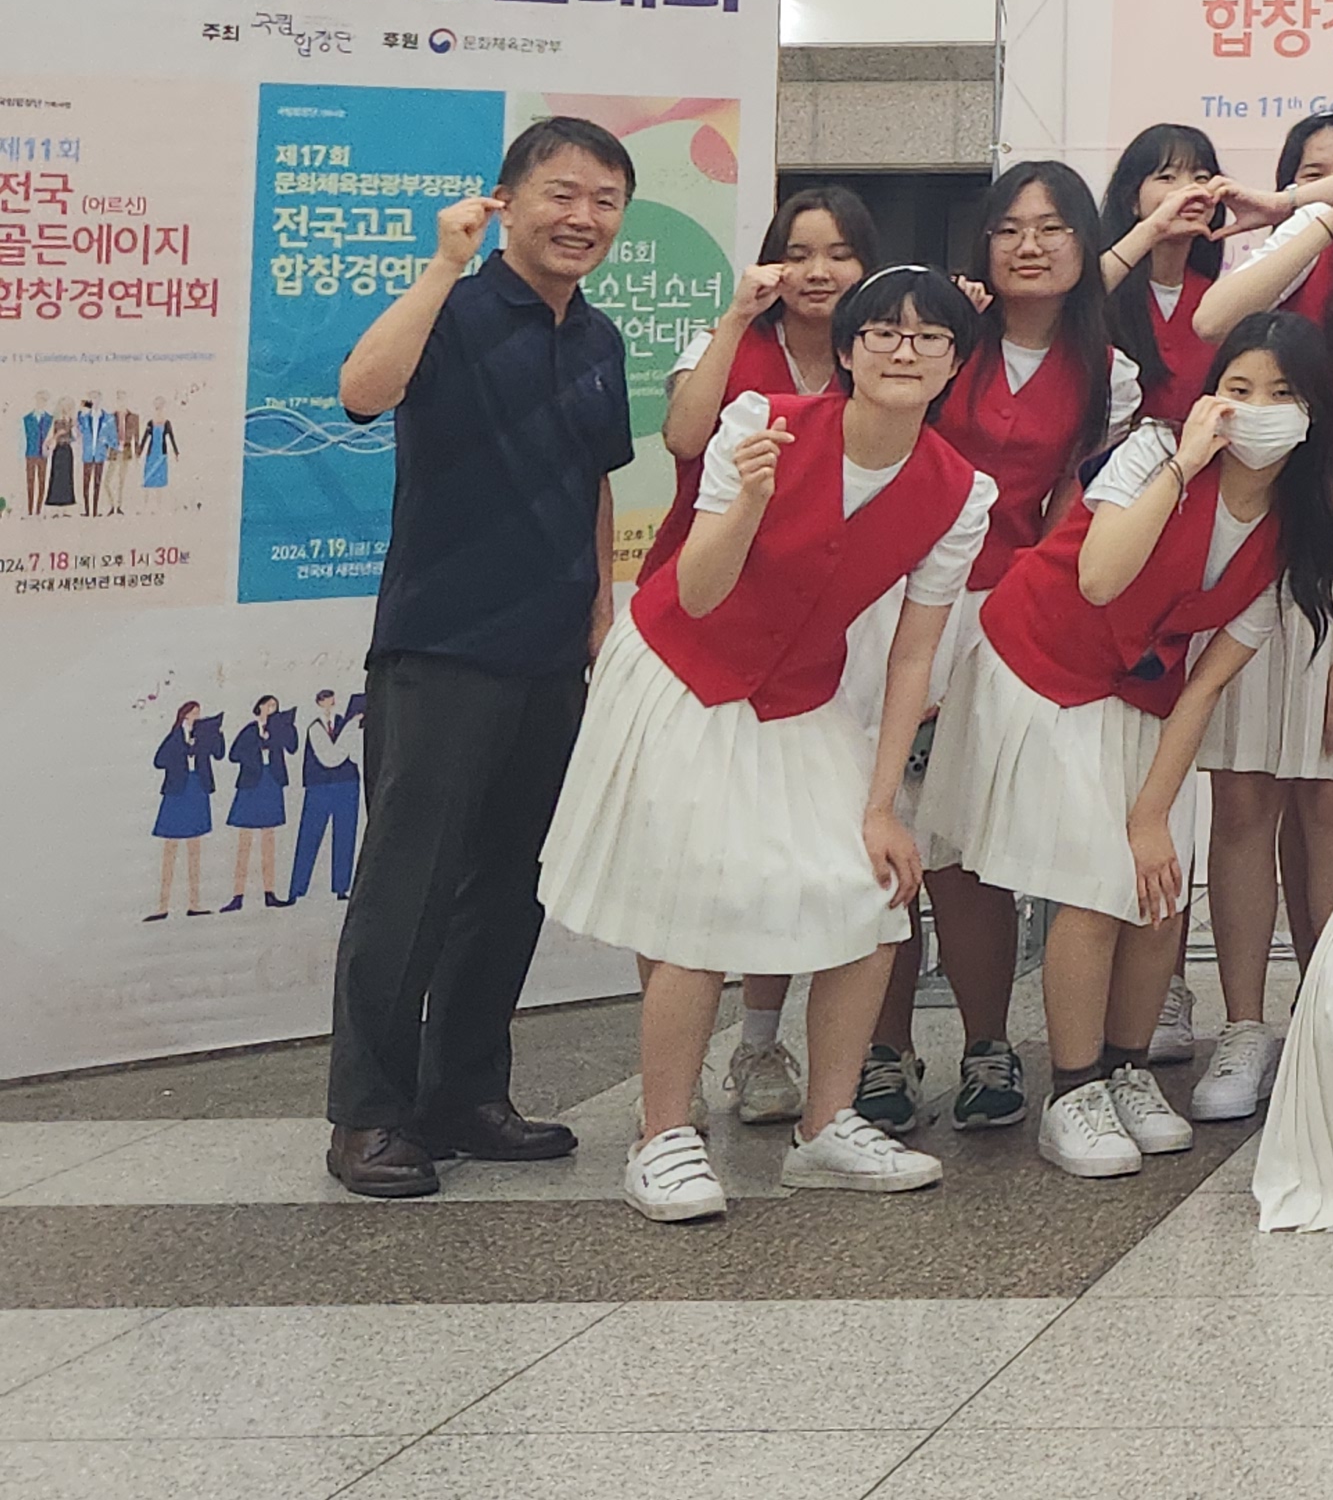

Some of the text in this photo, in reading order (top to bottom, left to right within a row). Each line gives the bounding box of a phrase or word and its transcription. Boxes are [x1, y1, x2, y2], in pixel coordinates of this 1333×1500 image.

[202, 23, 240, 42] 주최
[1201, 95, 1249, 118] The
[274, 144, 351, 168] 제17회
[0, 170, 147, 216] 전국 (어르신)
[0, 223, 190, 266] 골든에이지
[272, 205, 417, 248] 전국고교
[270, 253, 484, 297] 합창경연
[578, 269, 722, 312] 소년소녀
